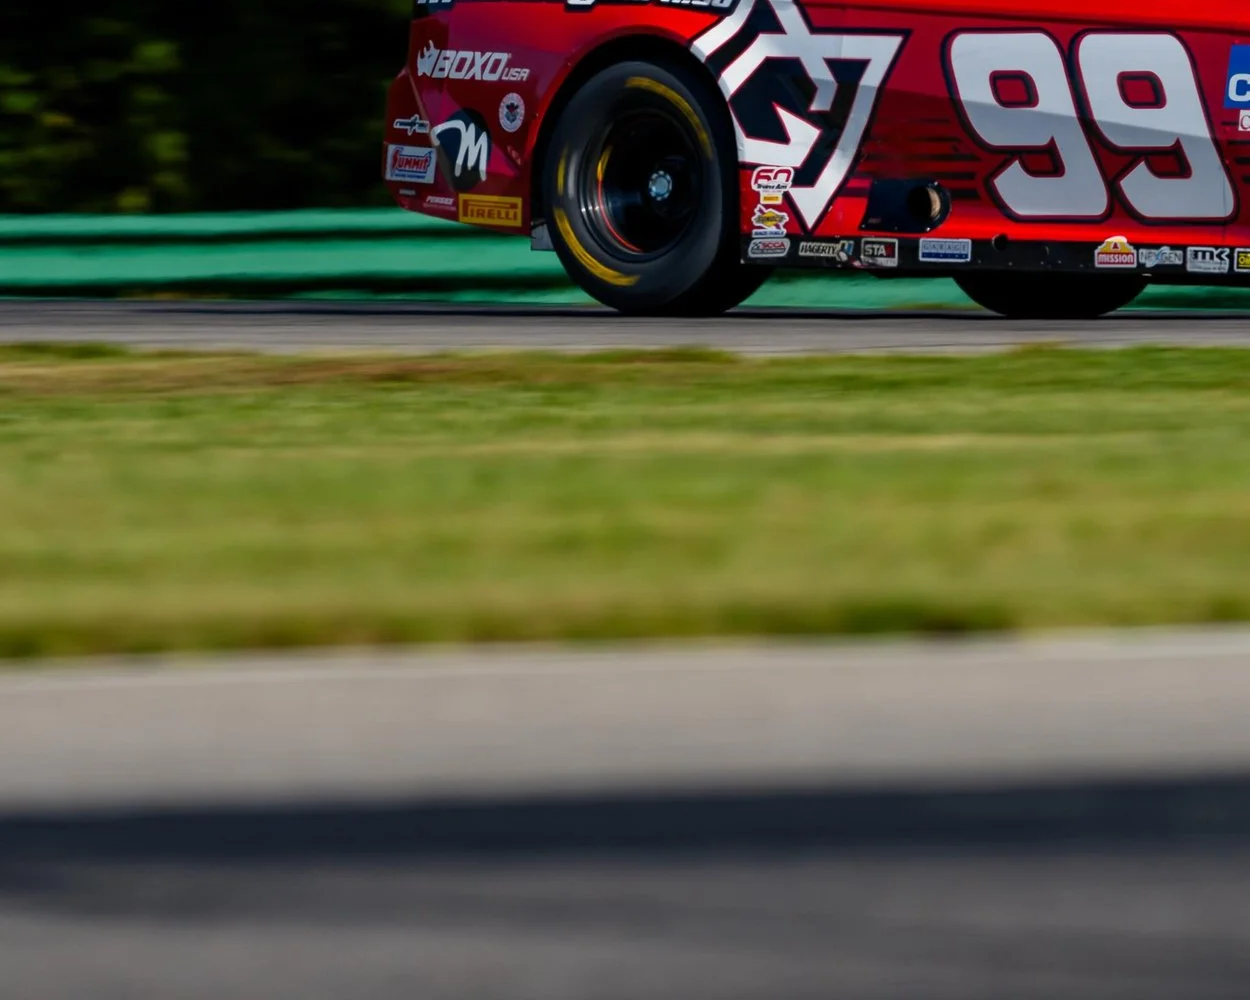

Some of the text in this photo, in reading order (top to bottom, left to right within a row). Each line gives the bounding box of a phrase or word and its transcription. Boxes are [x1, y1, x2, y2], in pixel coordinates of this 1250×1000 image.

[431, 50, 529, 81] BOXO USA
[951, 32, 1236, 218] 99
[462, 198, 518, 221] PIRELLI
[801, 243, 837, 256] HAGERTY
[1098, 253, 1134, 264] MISSION
